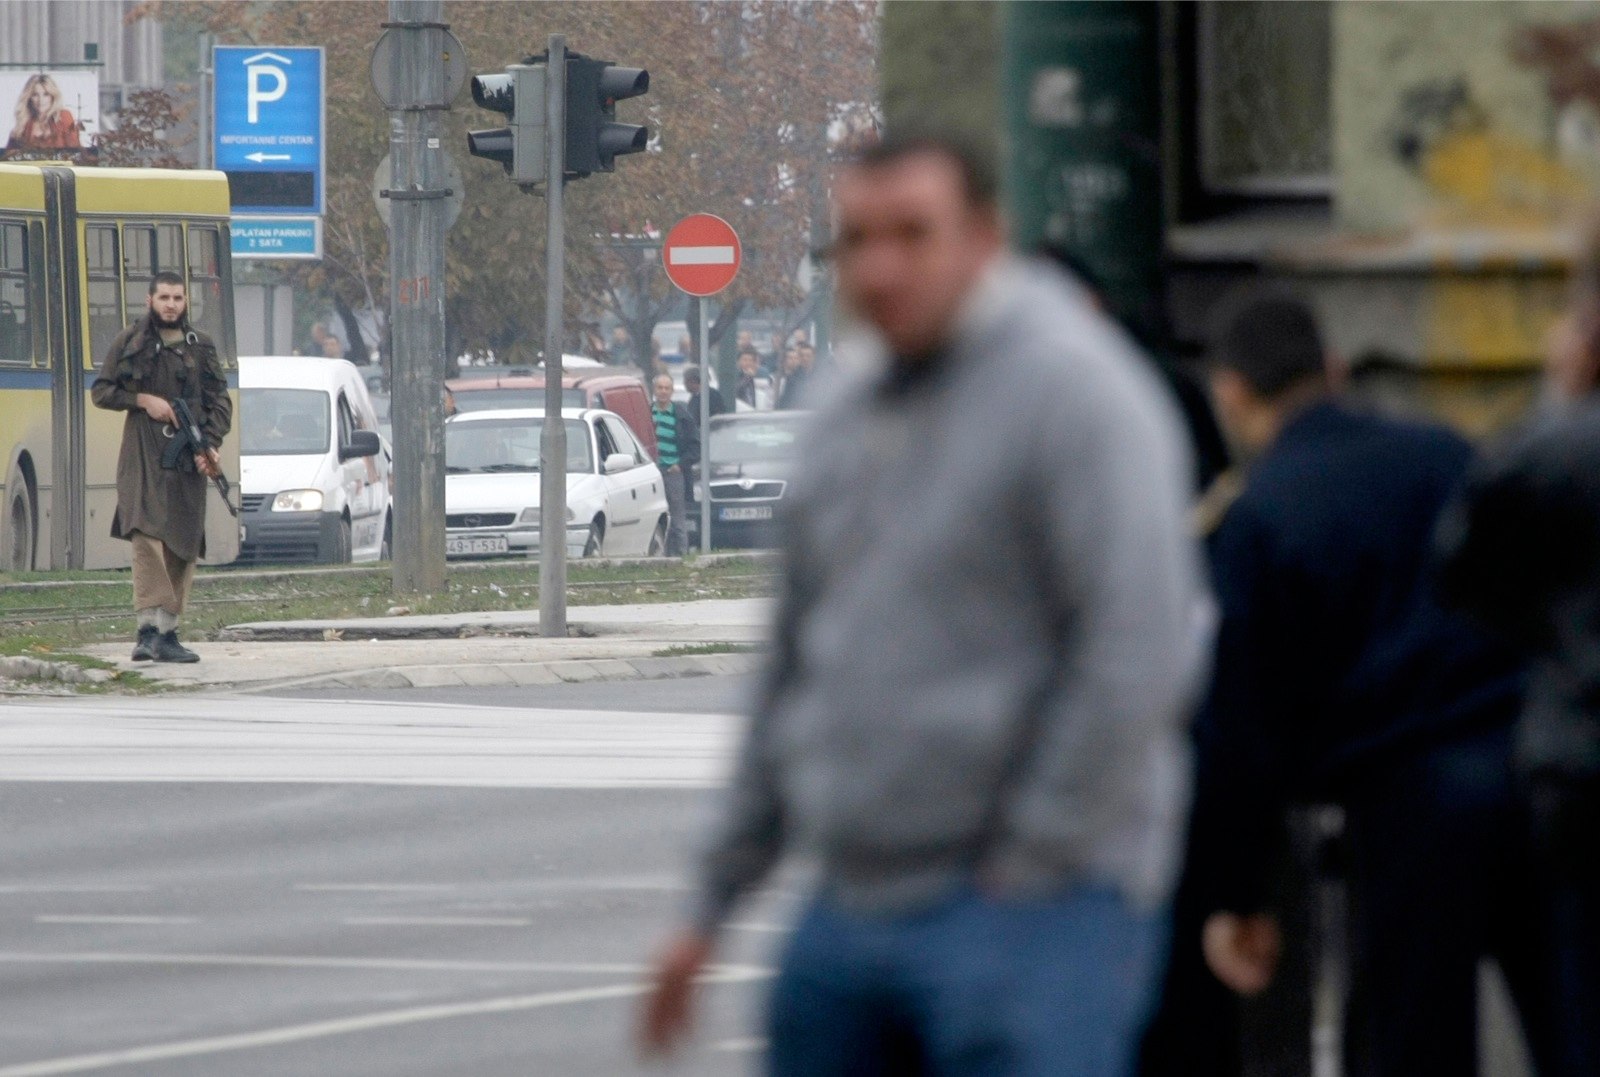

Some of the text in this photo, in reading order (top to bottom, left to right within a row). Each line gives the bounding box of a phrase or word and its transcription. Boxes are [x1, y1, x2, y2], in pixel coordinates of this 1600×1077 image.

[247, 65, 287, 123] P
[220, 135, 314, 145] IMPORTANNE CENTAR
[272, 228, 313, 238] PARKING
[259, 238, 283, 247] SATA
